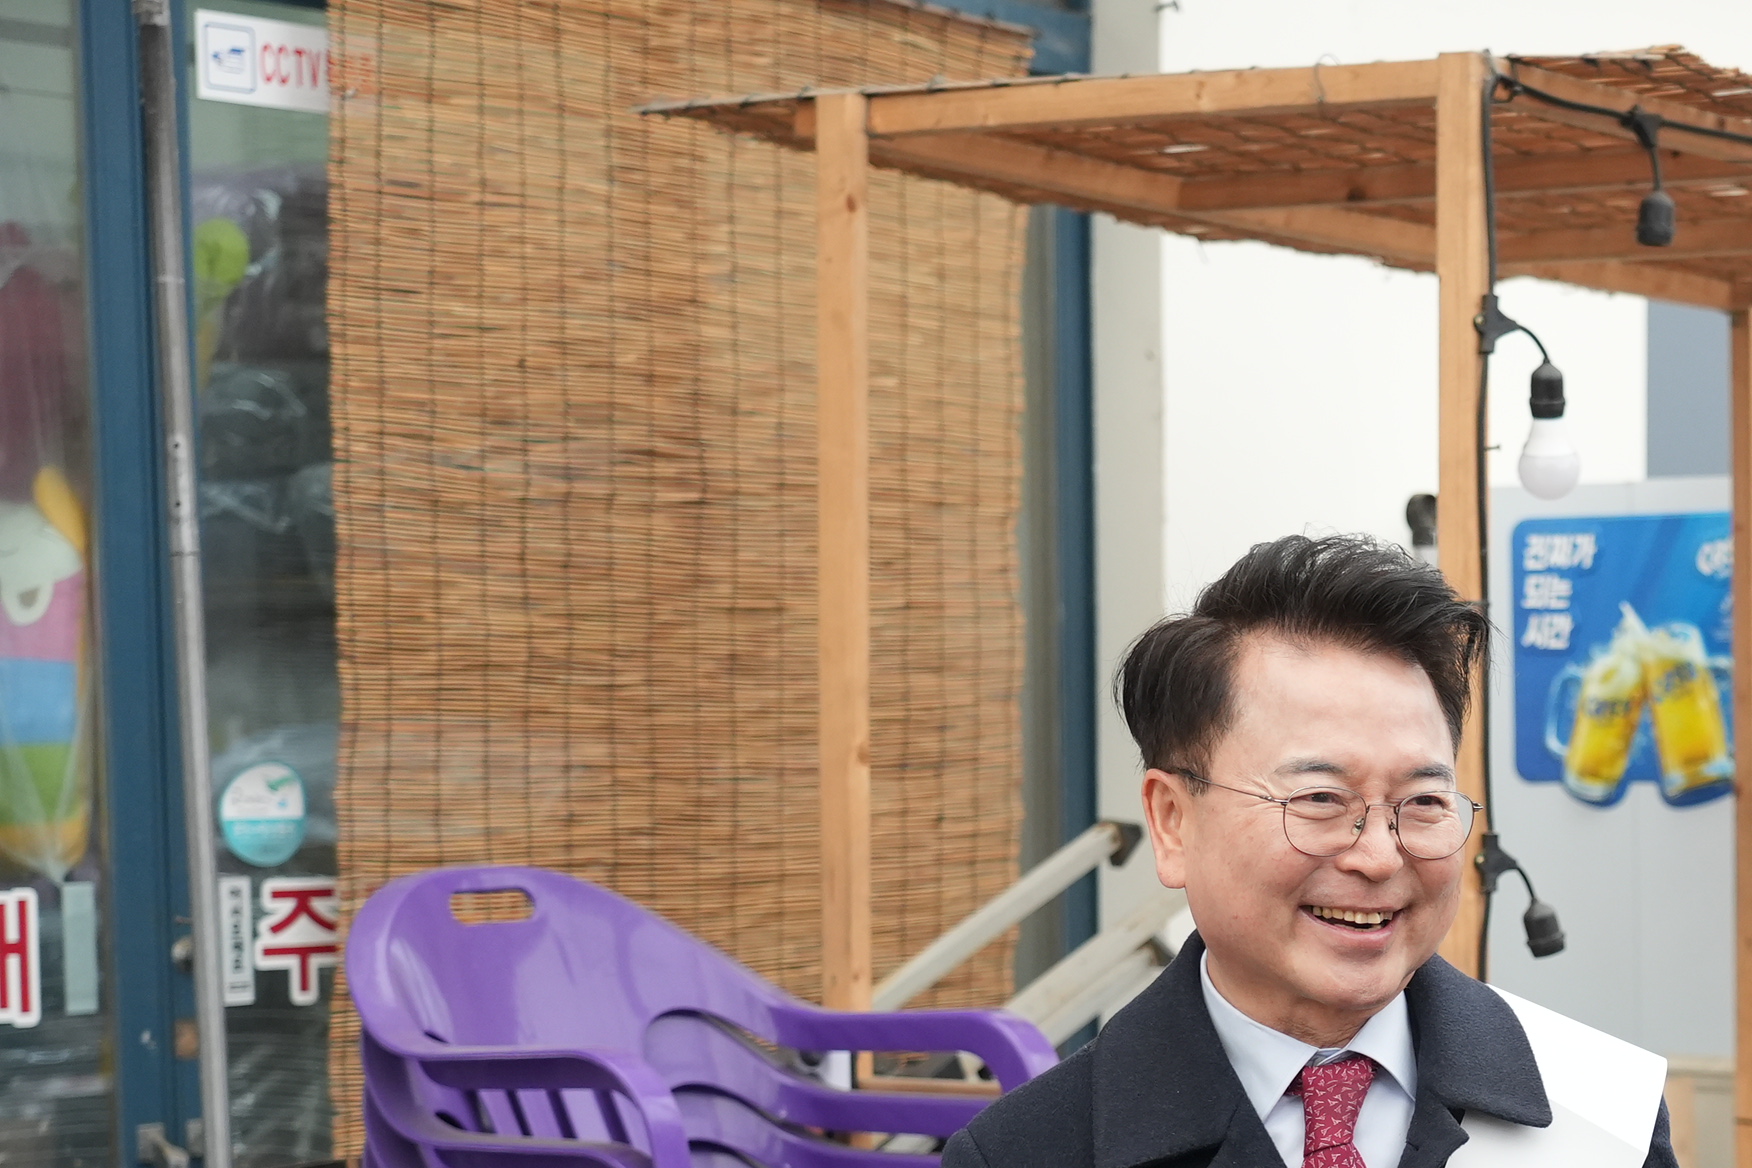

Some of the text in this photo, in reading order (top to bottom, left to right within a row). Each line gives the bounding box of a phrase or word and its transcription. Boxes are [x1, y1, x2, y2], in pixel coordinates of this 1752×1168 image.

[261, 43, 321, 90] CCTV
[1523, 533, 1598, 571] 진짜가
[1521, 572, 1573, 610] 되는
[1521, 611, 1574, 650] 시간
